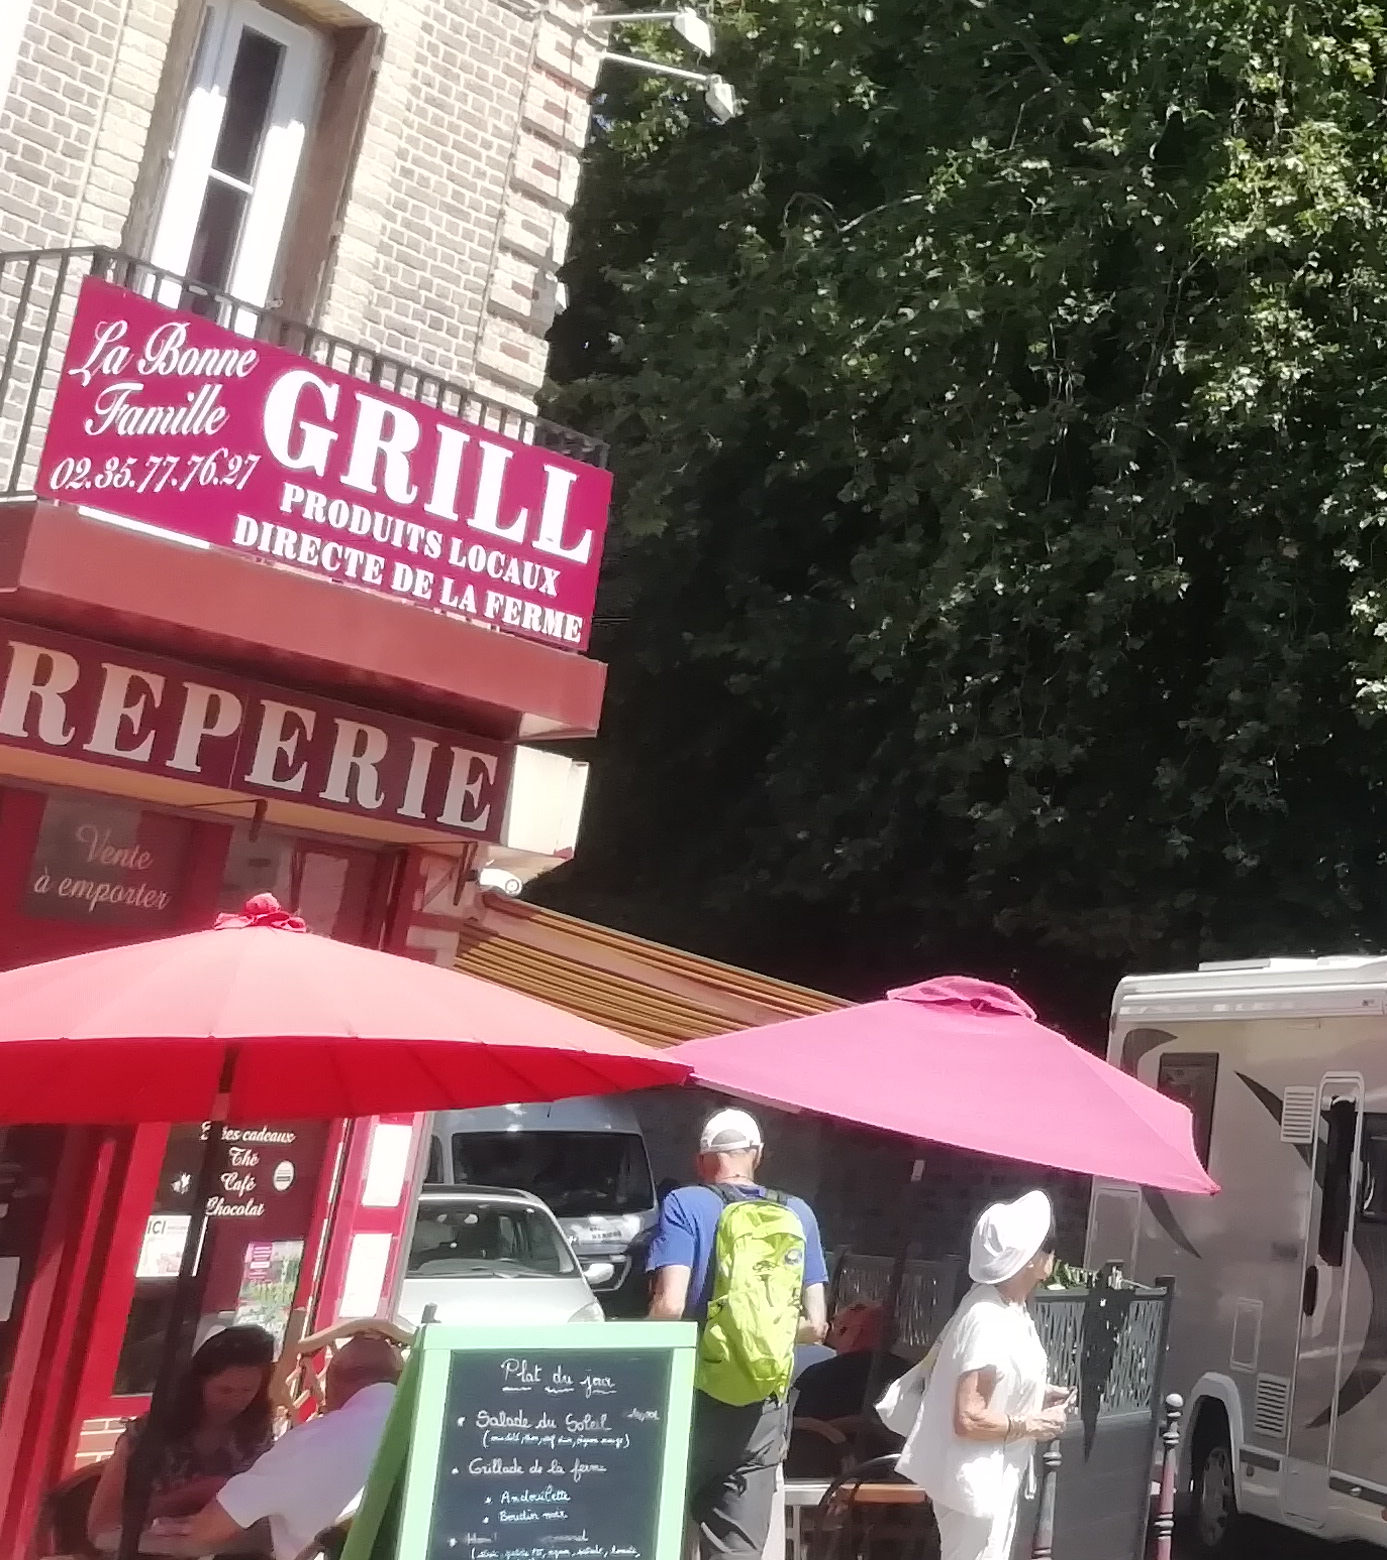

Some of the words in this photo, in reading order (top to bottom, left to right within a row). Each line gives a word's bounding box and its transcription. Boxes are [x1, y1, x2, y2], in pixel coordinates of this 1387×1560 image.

[68, 319, 135, 387] La
[137, 321, 260, 378] Bonne
[85, 382, 230, 435] Famille
[50, 446, 261, 493] 02.35.77.76.27
[263, 369, 594, 565] GRILL
[280, 482, 443, 559] PRODUITS
[449, 537, 560, 596] LOCAUX
[232, 514, 385, 586] DIRECTE
[391, 562, 434, 600] DE
[439, 576, 477, 614] LA
[484, 589, 583, 644] FERME
[0, 640, 498, 832] REPERIE
[75, 823, 154, 870] Vente
[34, 866, 51, 894] à
[58, 876, 171, 912] emporter
[229, 1146, 260, 1166] Thé
[242, 1125, 297, 1143] cadeaux
[205, 1196, 265, 1217] Chocolat
[220, 1172, 257, 1197] Café
[147, 1220, 166, 1235] ICI
[501, 1358, 542, 1382] Plat
[552, 1365, 574, 1385] du
[475, 1409, 533, 1428] Salade
[534, 1412, 557, 1429] du
[565, 1413, 612, 1432] Soleil
[469, 1457, 525, 1474] Grillade
[529, 1458, 543, 1474] de
